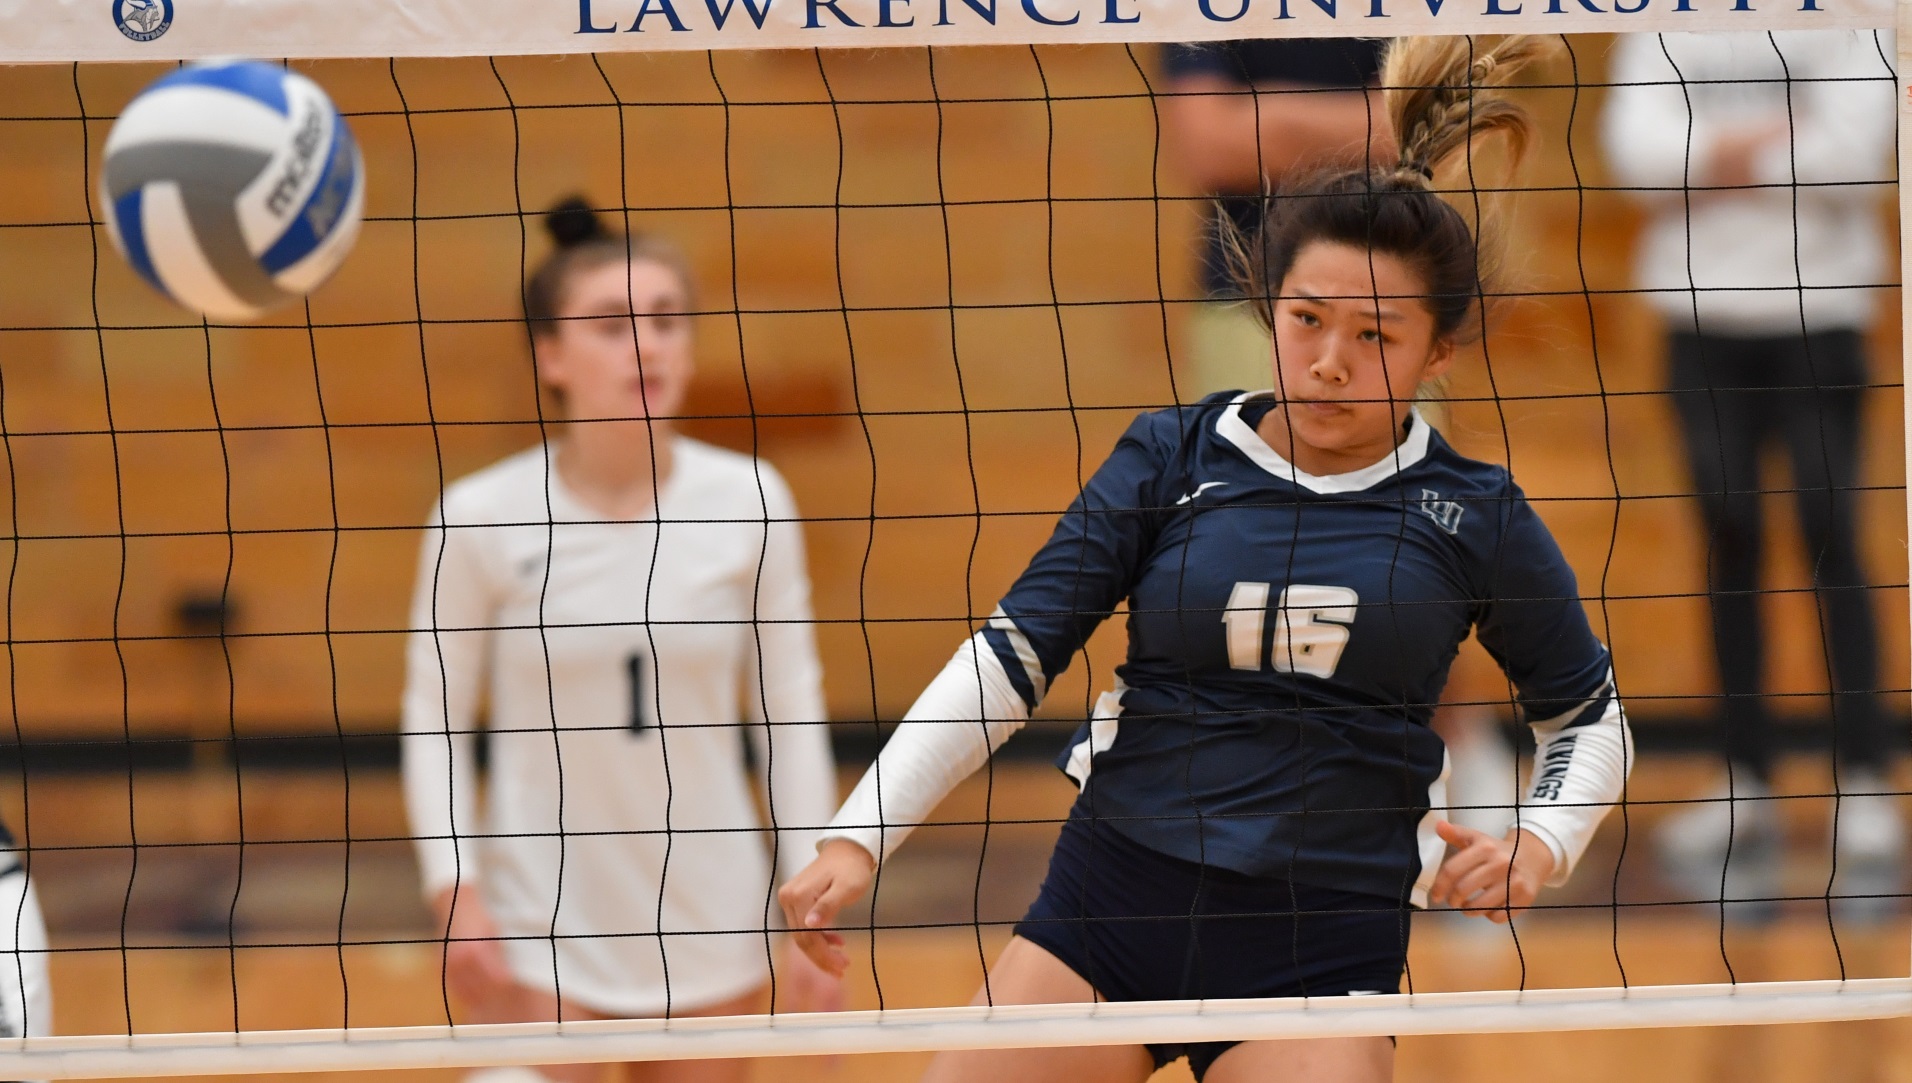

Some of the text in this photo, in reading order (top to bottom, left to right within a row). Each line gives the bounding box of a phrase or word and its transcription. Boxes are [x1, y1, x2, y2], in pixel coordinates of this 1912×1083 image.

[264, 98, 322, 219] mole
[1221, 581, 1359, 679] 16
[624, 651, 648, 738] 1
[1531, 733, 1578, 801] VIKINGS
